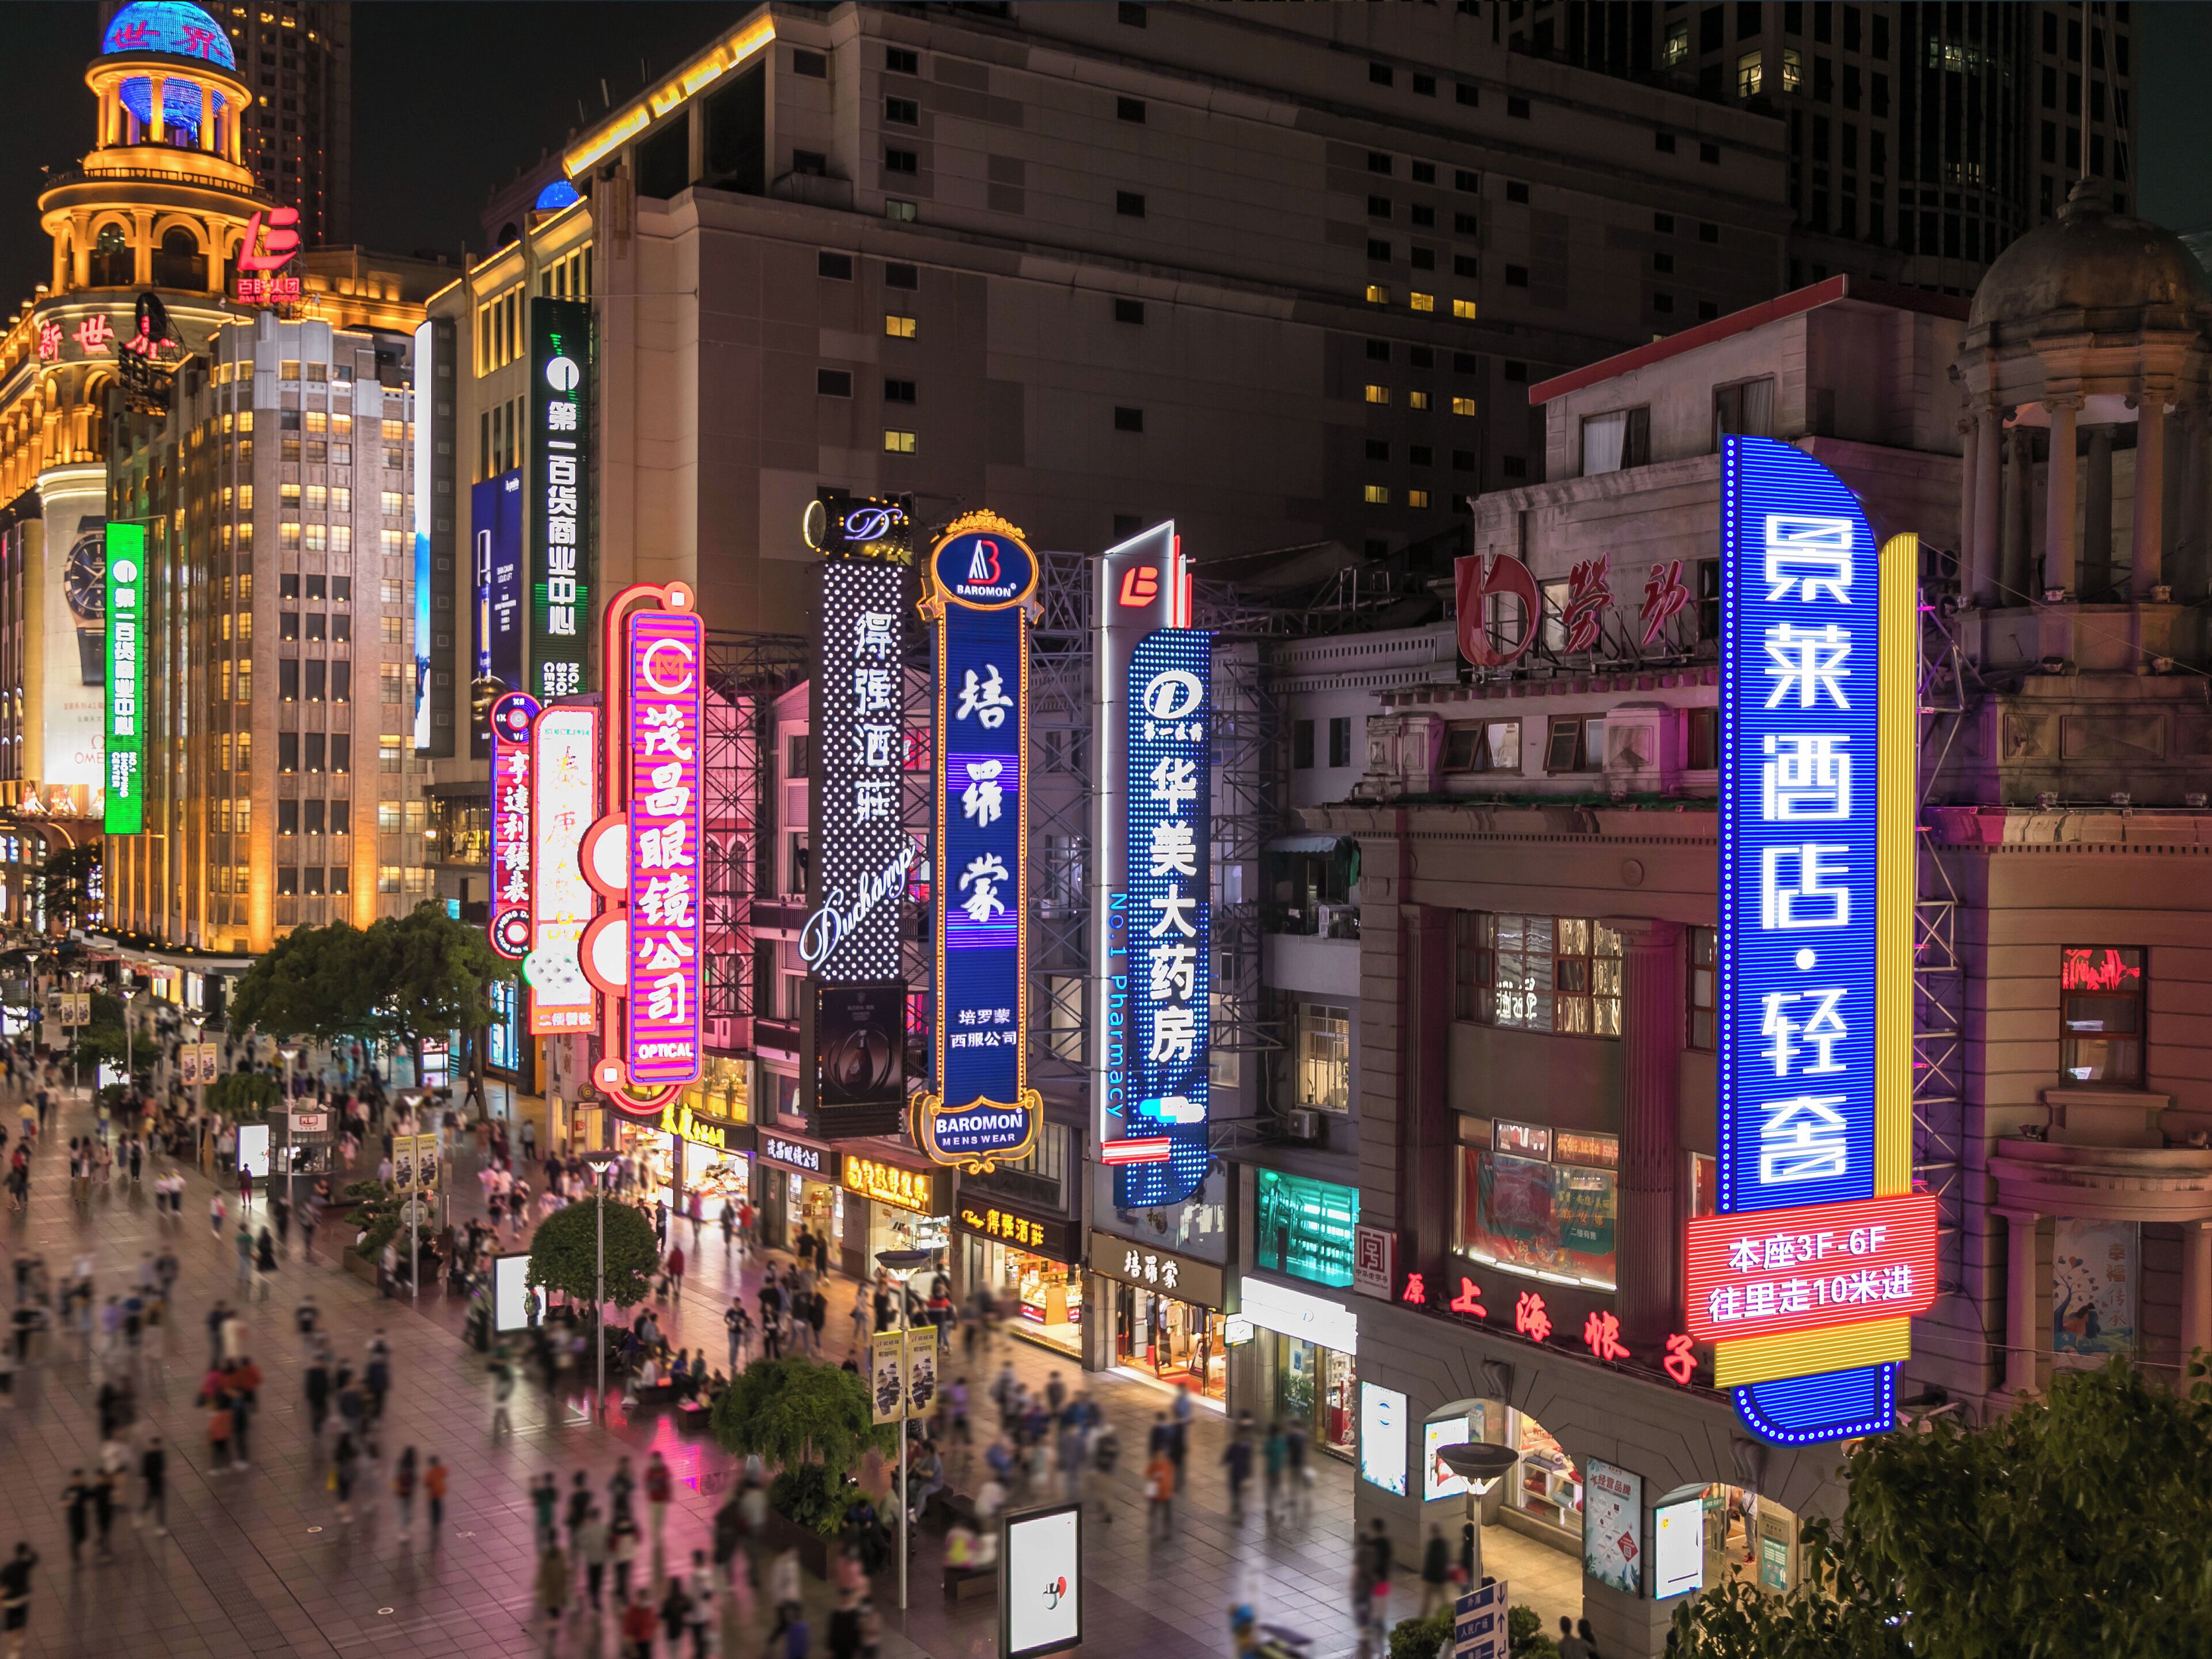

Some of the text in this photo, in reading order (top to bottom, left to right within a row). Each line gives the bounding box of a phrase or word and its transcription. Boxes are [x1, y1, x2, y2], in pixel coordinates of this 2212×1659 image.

[109, 20, 230, 59] 世界
[238, 278, 300, 294] 百联集团
[547, 402, 577, 635] 第一百货商业中心
[956, 584, 1012, 597] BAROMON
[568, 662, 579, 694] NO.1
[75, 752, 104, 764] OME
[112, 752, 120, 788] CENTER
[128, 752, 138, 772] NO.1
[120, 752, 129, 798] SHOPPING
[639, 704, 694, 1024] 茂昌眼镜公司
[799, 844, 916, 971] Duchamp
[1149, 756, 1197, 1063] 华美大药房
[959, 1008, 1011, 1025] 培罗蒙
[639, 1043, 694, 1059] OPTICAL
[950, 1031, 1017, 1048] 西服公司
[1106, 975, 1127, 1118] Pharmacy
[936, 1113, 1022, 1134] BAROMON
[942, 1133, 1015, 1146] MENS WEAR
[767, 1139, 819, 1171] 茂昌眼镜公司
[1729, 1226, 1887, 1273] 本座3F-6F
[1707, 1264, 1913, 1323] 往里走10米进
[1598, 1474, 1631, 1496] 经营品牌
[1461, 1618, 1488, 1638] 人民广场
